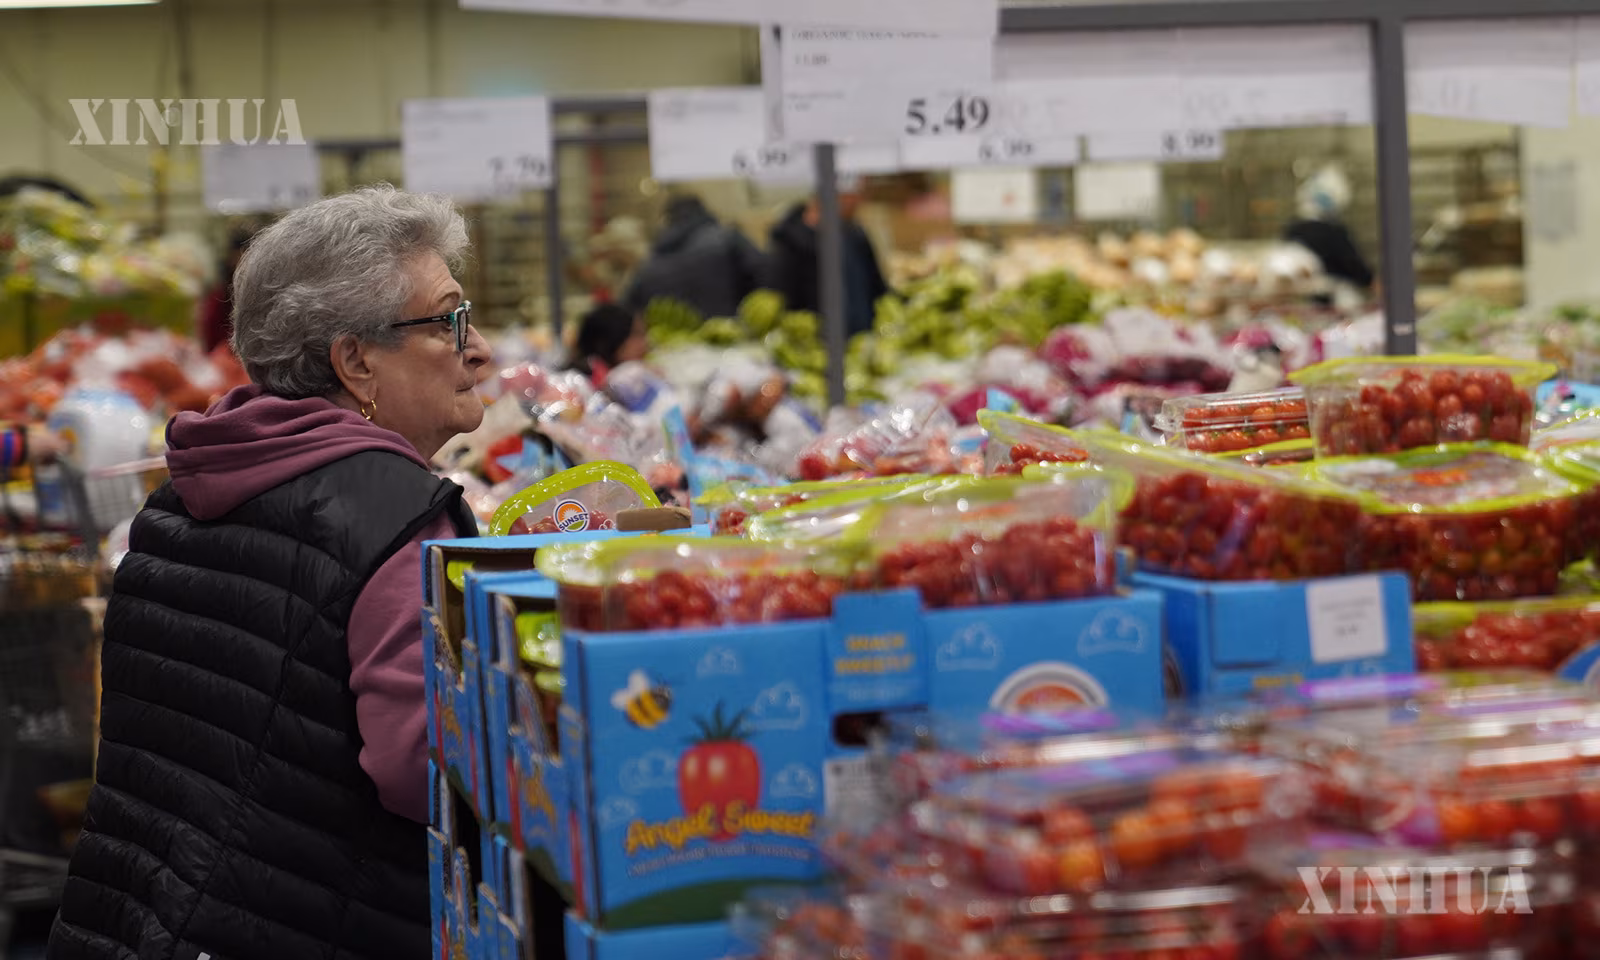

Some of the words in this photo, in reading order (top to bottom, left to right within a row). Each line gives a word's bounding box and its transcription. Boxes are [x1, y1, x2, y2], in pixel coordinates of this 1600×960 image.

[904, 97, 991, 136] 5.49
[558, 512, 589, 531] SUNSET
[625, 803, 716, 857] Angel
[722, 799, 815, 838] Sweet
